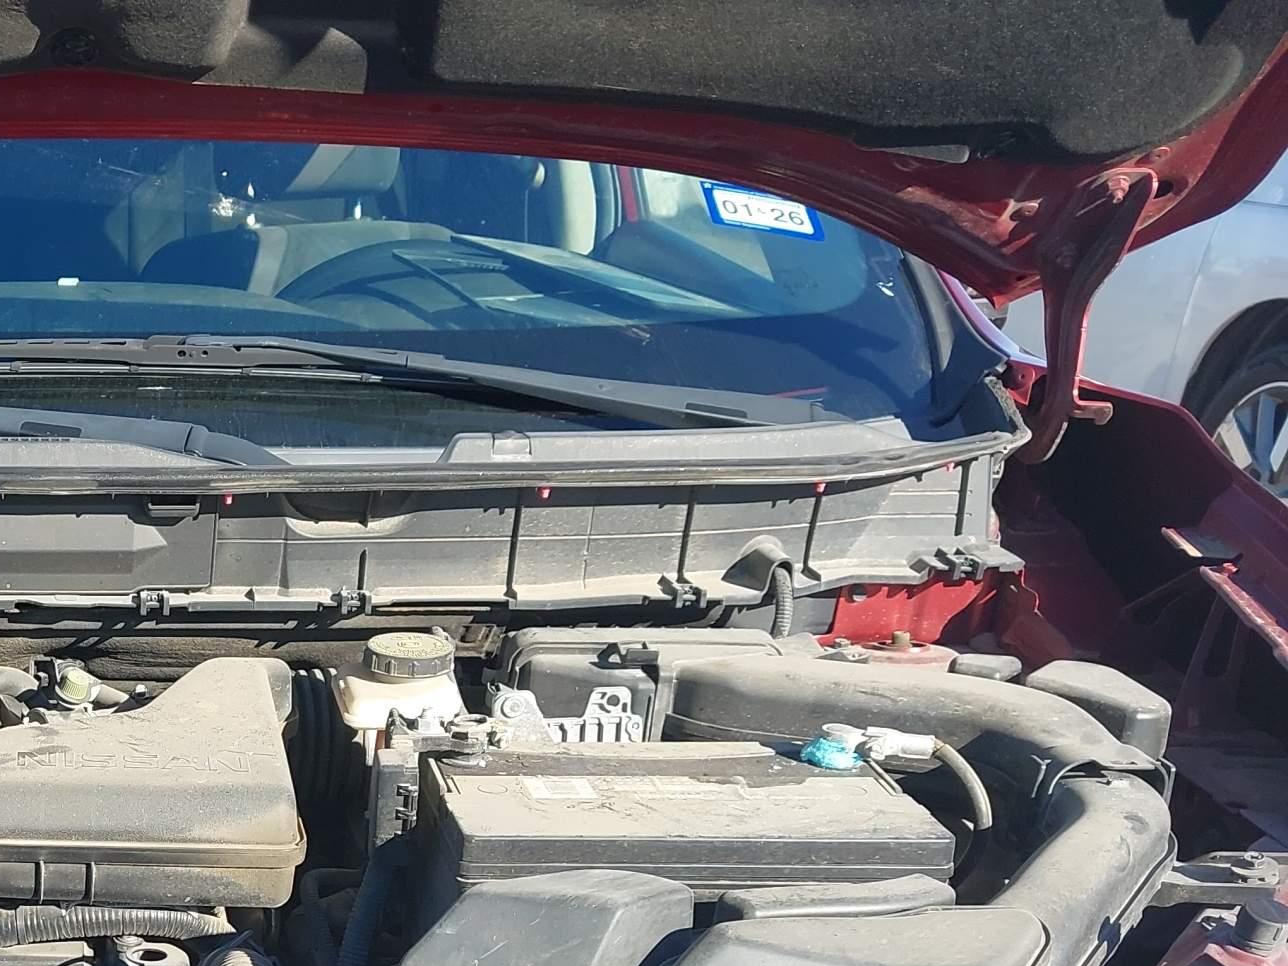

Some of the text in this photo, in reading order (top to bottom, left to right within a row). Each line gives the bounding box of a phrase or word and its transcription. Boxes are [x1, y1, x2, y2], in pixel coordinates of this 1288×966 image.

[722, 199, 753, 217] 01
[770, 208, 805, 226] 26
[15, 750, 252, 773] NISSAN
